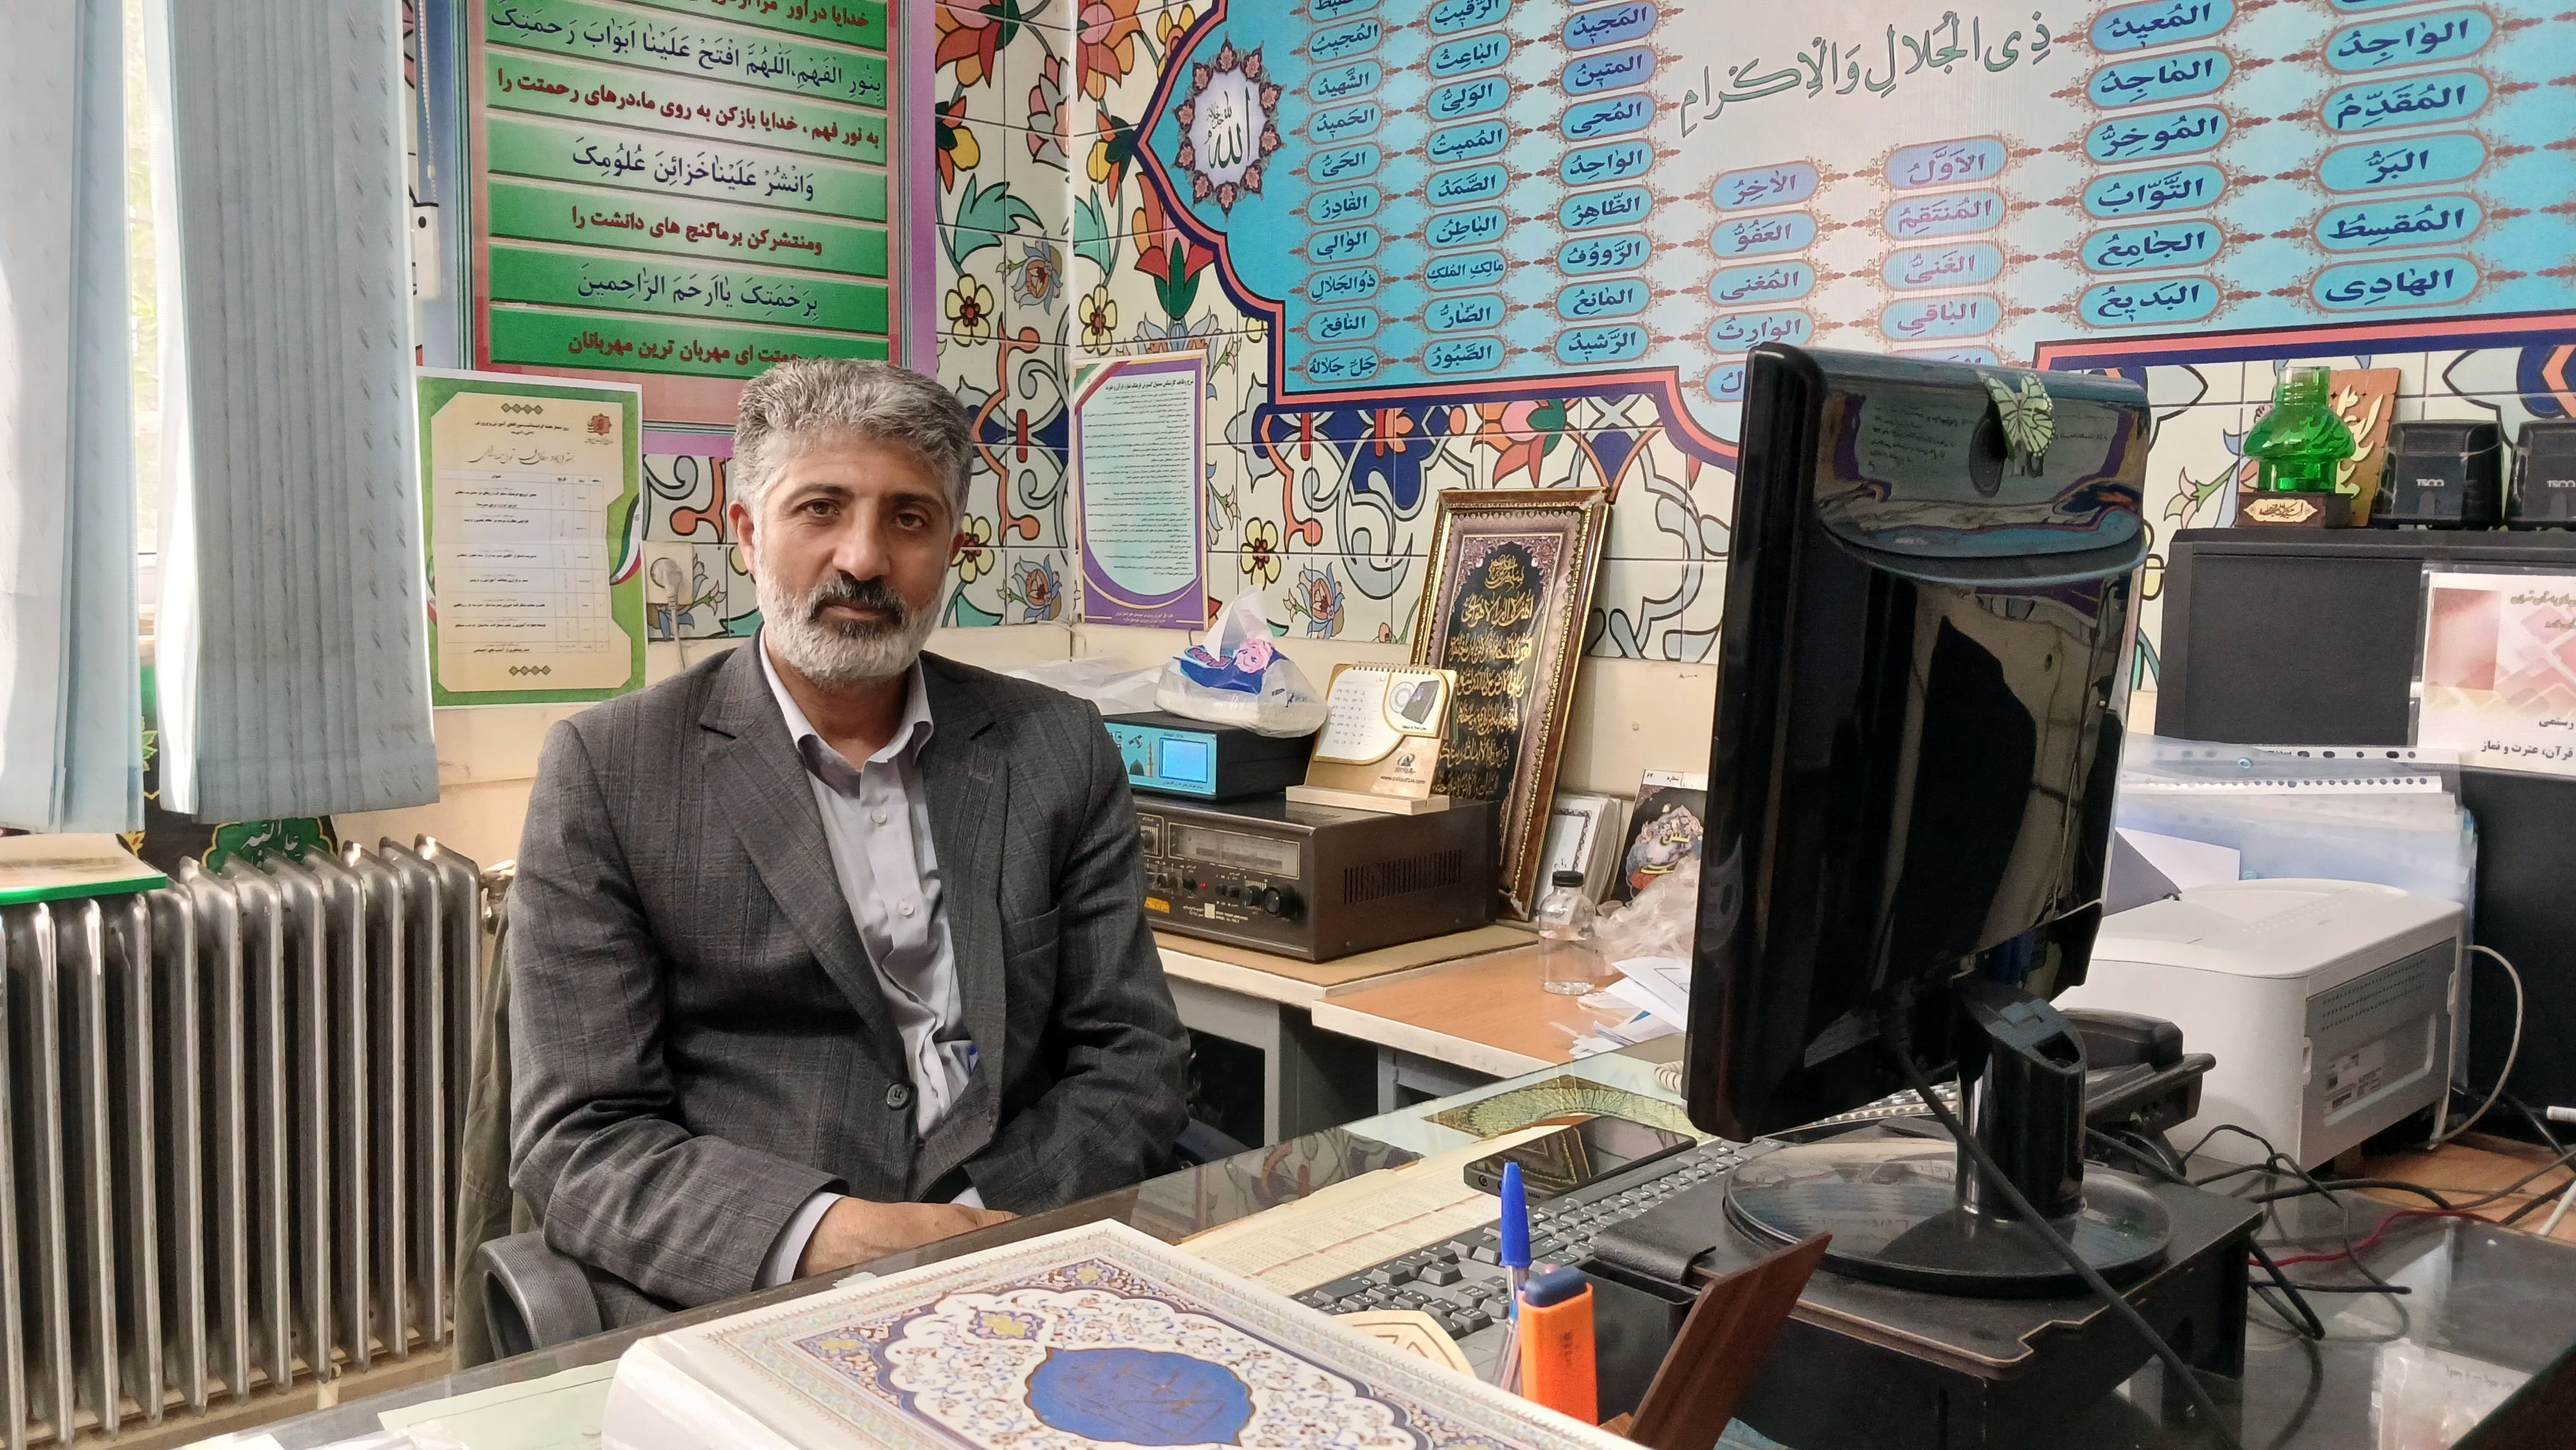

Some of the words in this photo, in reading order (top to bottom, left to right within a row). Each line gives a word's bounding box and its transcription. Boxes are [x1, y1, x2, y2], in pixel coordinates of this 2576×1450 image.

[832, 6, 869, 27] خدایا
[498, 67, 513, 93] را
[517, 76, 580, 103] رحمتت
[660, 102, 691, 119] روی
[696, 104, 711, 122] به
[760, 110, 798, 131] خدایا
[811, 122, 838, 142] فهم
[842, 127, 862, 146] نور
[866, 129, 879, 149] به
[571, 205, 586, 229] را
[590, 211, 645, 231] دانشت
[650, 217, 681, 238] های
[569, 331, 633, 355] مهربانان
[638, 339, 675, 359] ترین
[679, 340, 730, 362] مهربان
[735, 345, 754, 366] ای
[2481, 740, 2500, 752] نماز
